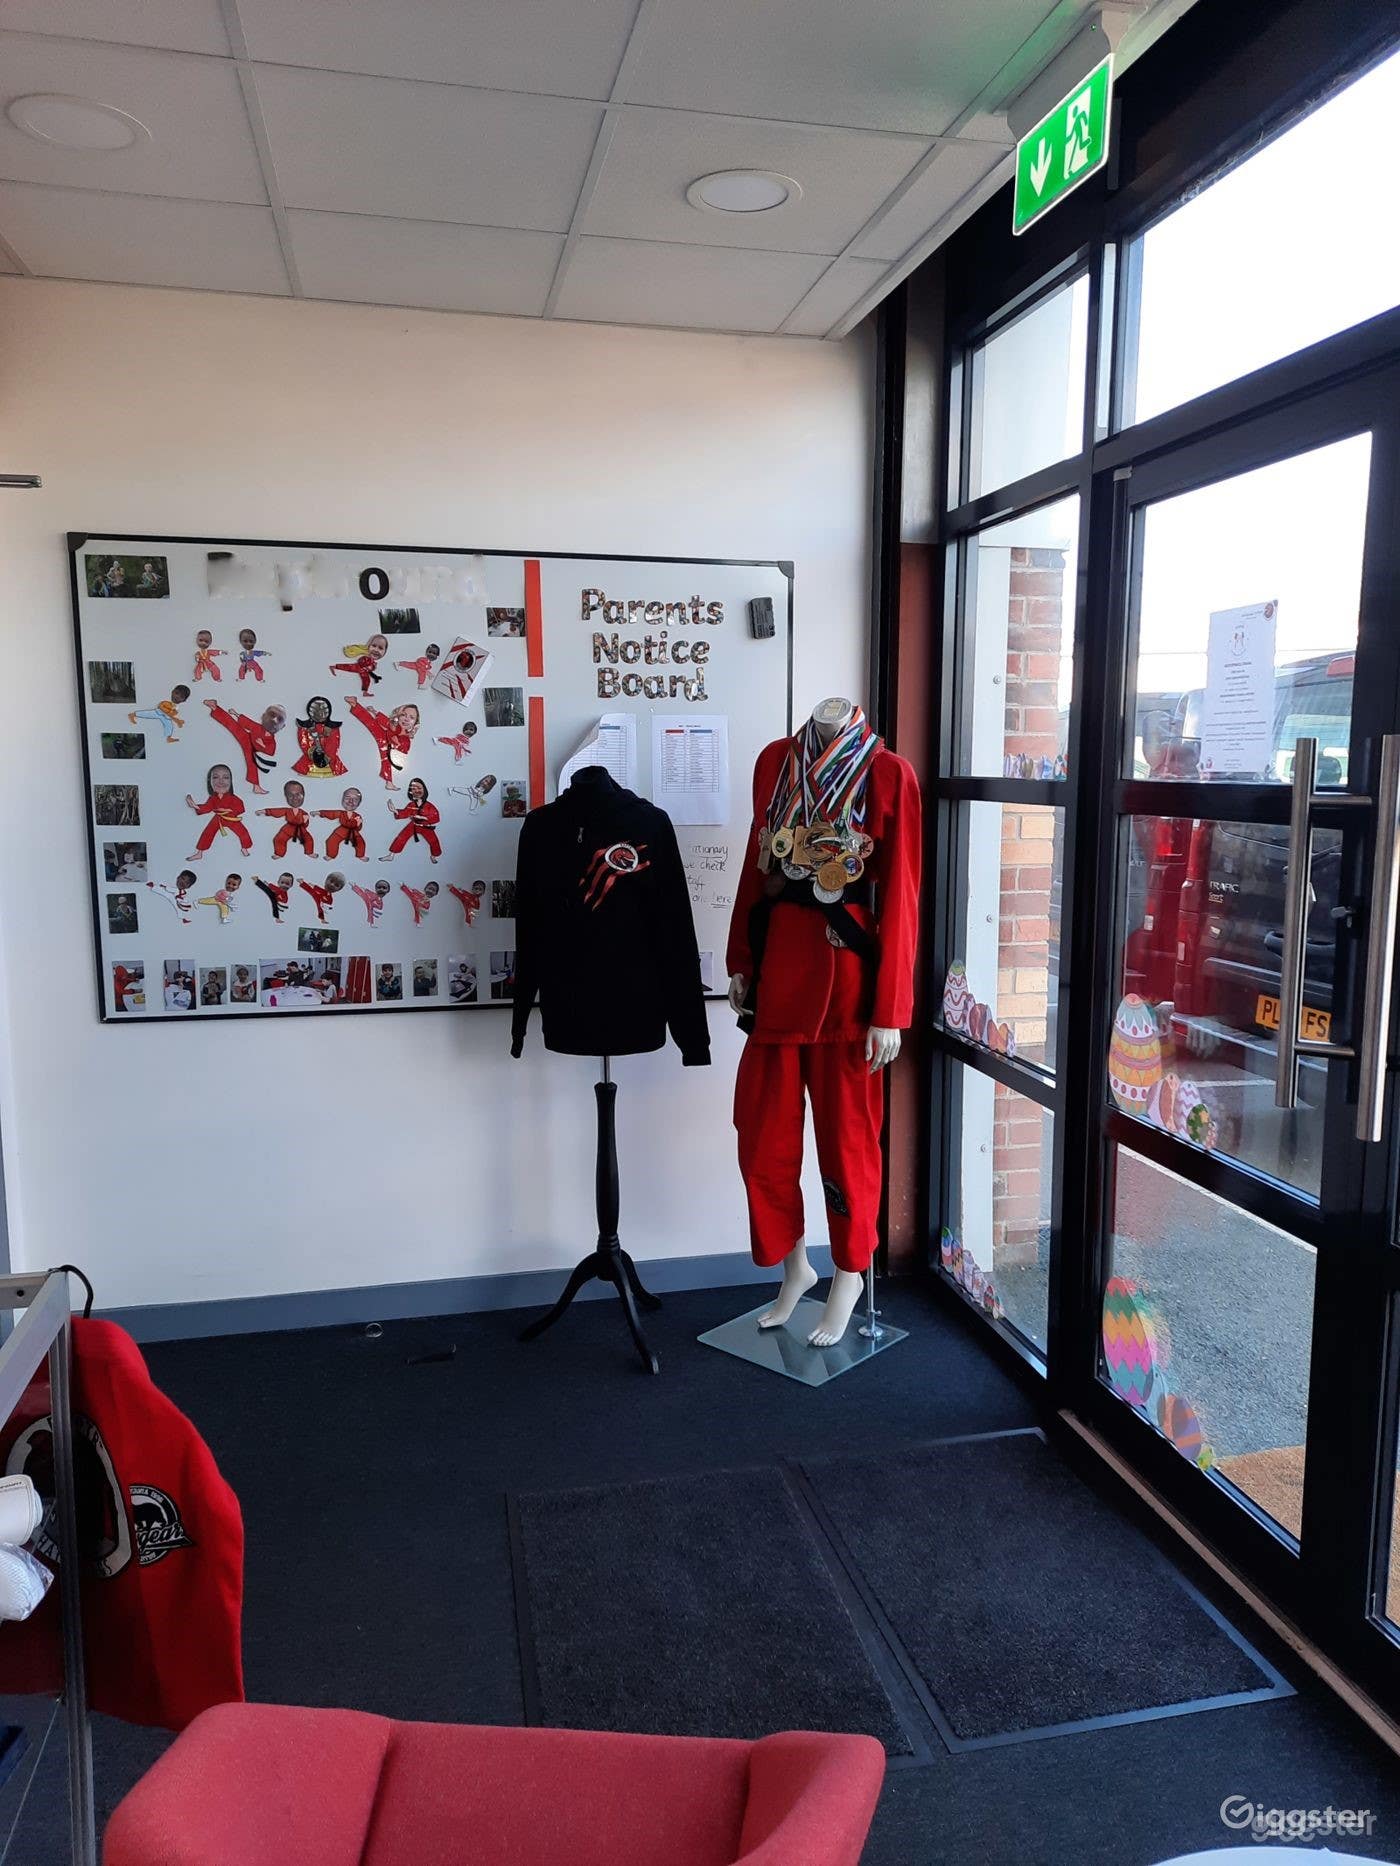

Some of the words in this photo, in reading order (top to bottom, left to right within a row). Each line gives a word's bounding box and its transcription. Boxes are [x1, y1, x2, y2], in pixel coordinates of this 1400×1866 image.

[581, 588, 725, 626] Parents
[592, 630, 711, 665] Notice
[597, 667, 709, 702] Board
